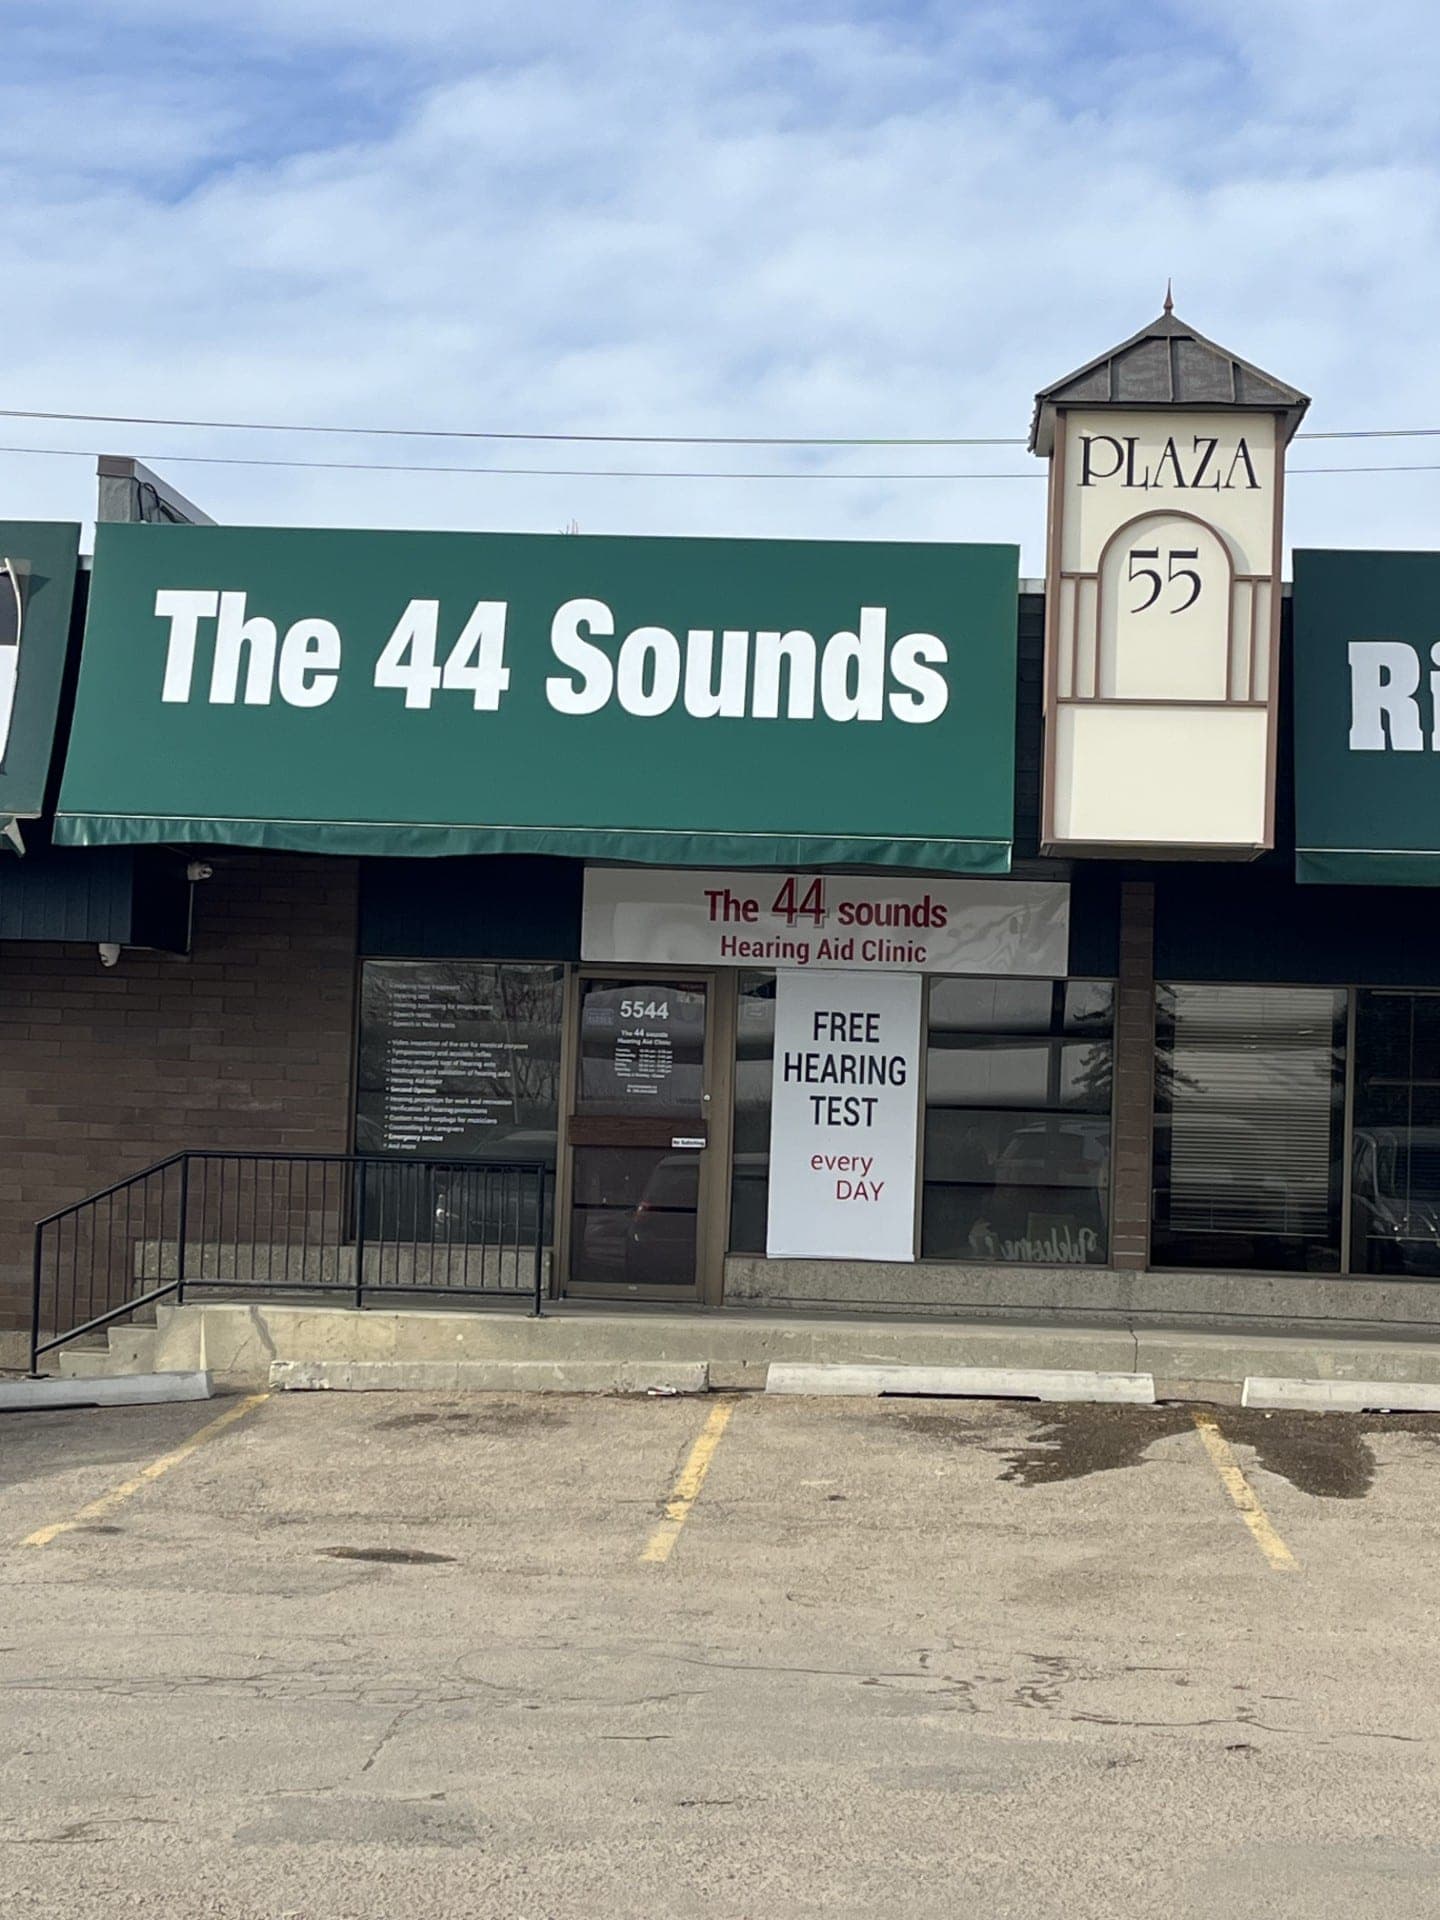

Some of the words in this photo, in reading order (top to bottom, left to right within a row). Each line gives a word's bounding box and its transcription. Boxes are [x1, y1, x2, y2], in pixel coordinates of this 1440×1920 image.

[1077, 435, 1261, 492] PLAZA
[1128, 547, 1202, 614] 55
[154, 589, 342, 708] The
[373, 599, 510, 712] 44
[545, 598, 950, 725] Sounds
[704, 889, 759, 923] The
[771, 876, 829, 928] 44
[837, 894, 948, 928] sounds
[720, 935, 809, 965] Hearing
[816, 937, 854, 961] Aid
[861, 938, 927, 963] Clinic
[620, 1000, 669, 1020] 5544
[813, 1010, 881, 1044] FREE
[783, 1052, 907, 1087] HEARING
[809, 1095, 879, 1127] TEST
[810, 1153, 874, 1178] every
[836, 1181, 885, 1203] DAY
